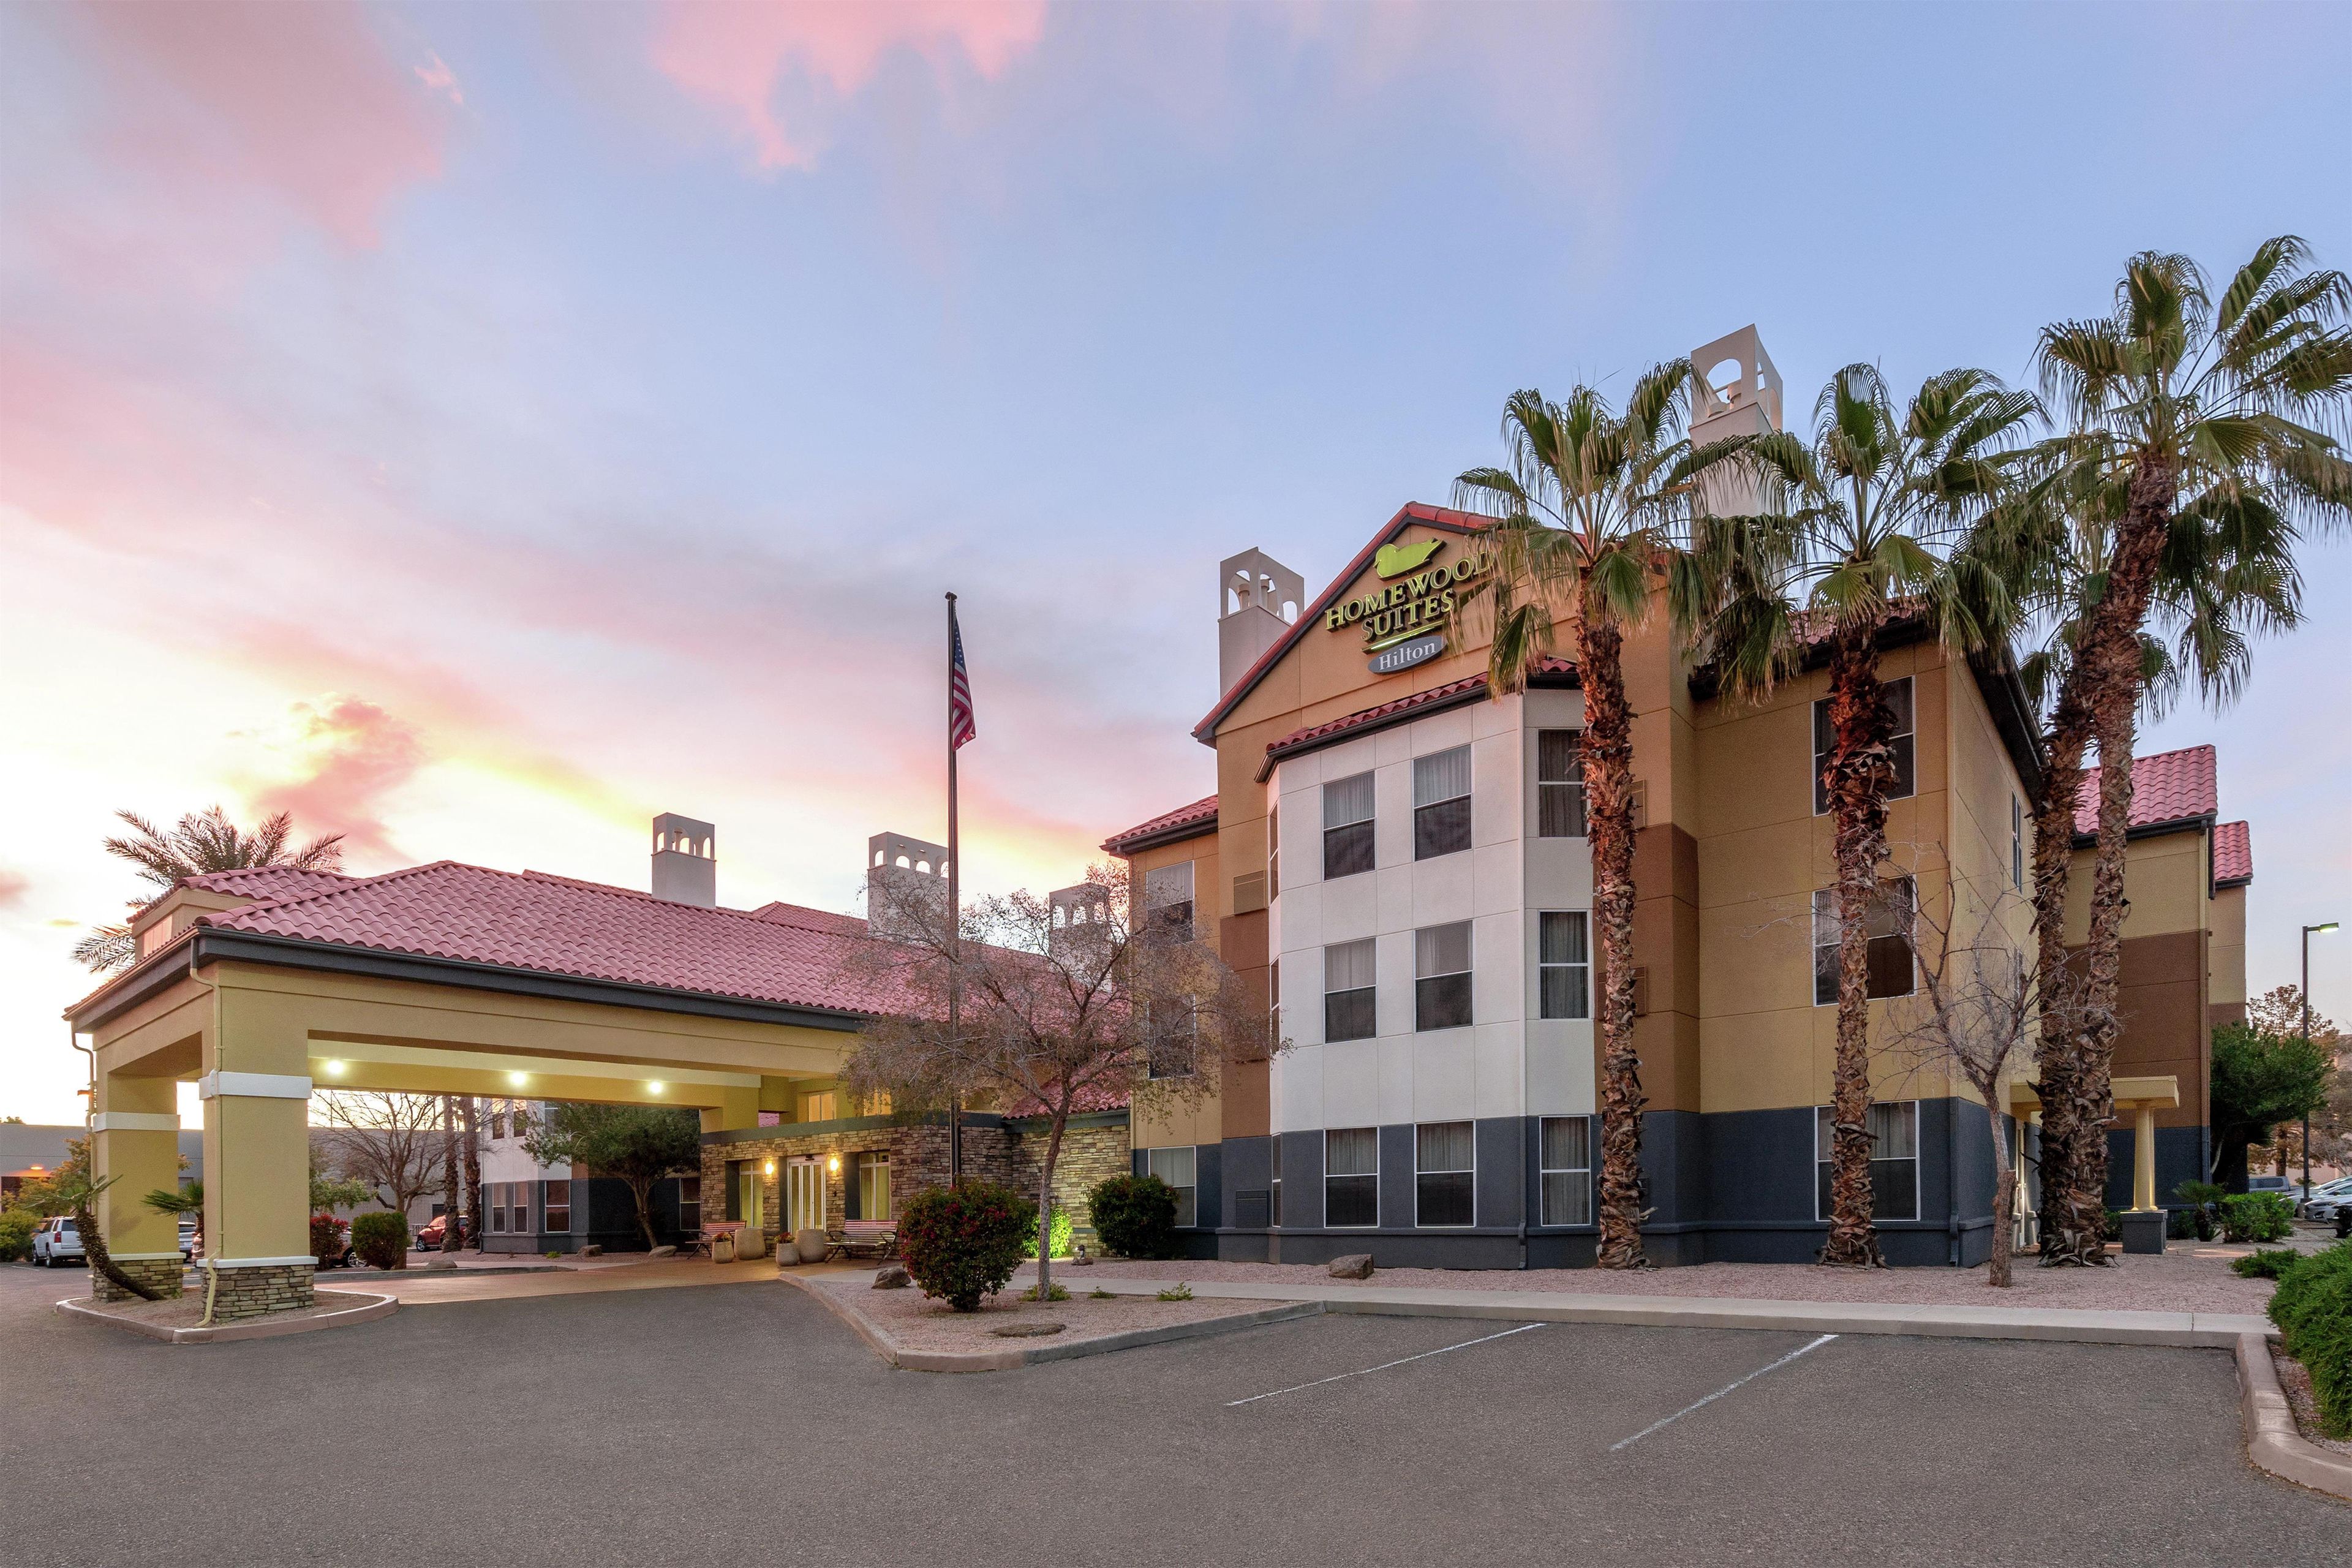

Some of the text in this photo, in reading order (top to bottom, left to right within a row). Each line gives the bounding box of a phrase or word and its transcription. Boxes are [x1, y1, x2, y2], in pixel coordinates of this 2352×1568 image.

[1325, 551, 1495, 631] HOMEWOOD
[1361, 588, 1454, 641] SUITES
[1379, 643, 1436, 671] Hilton
